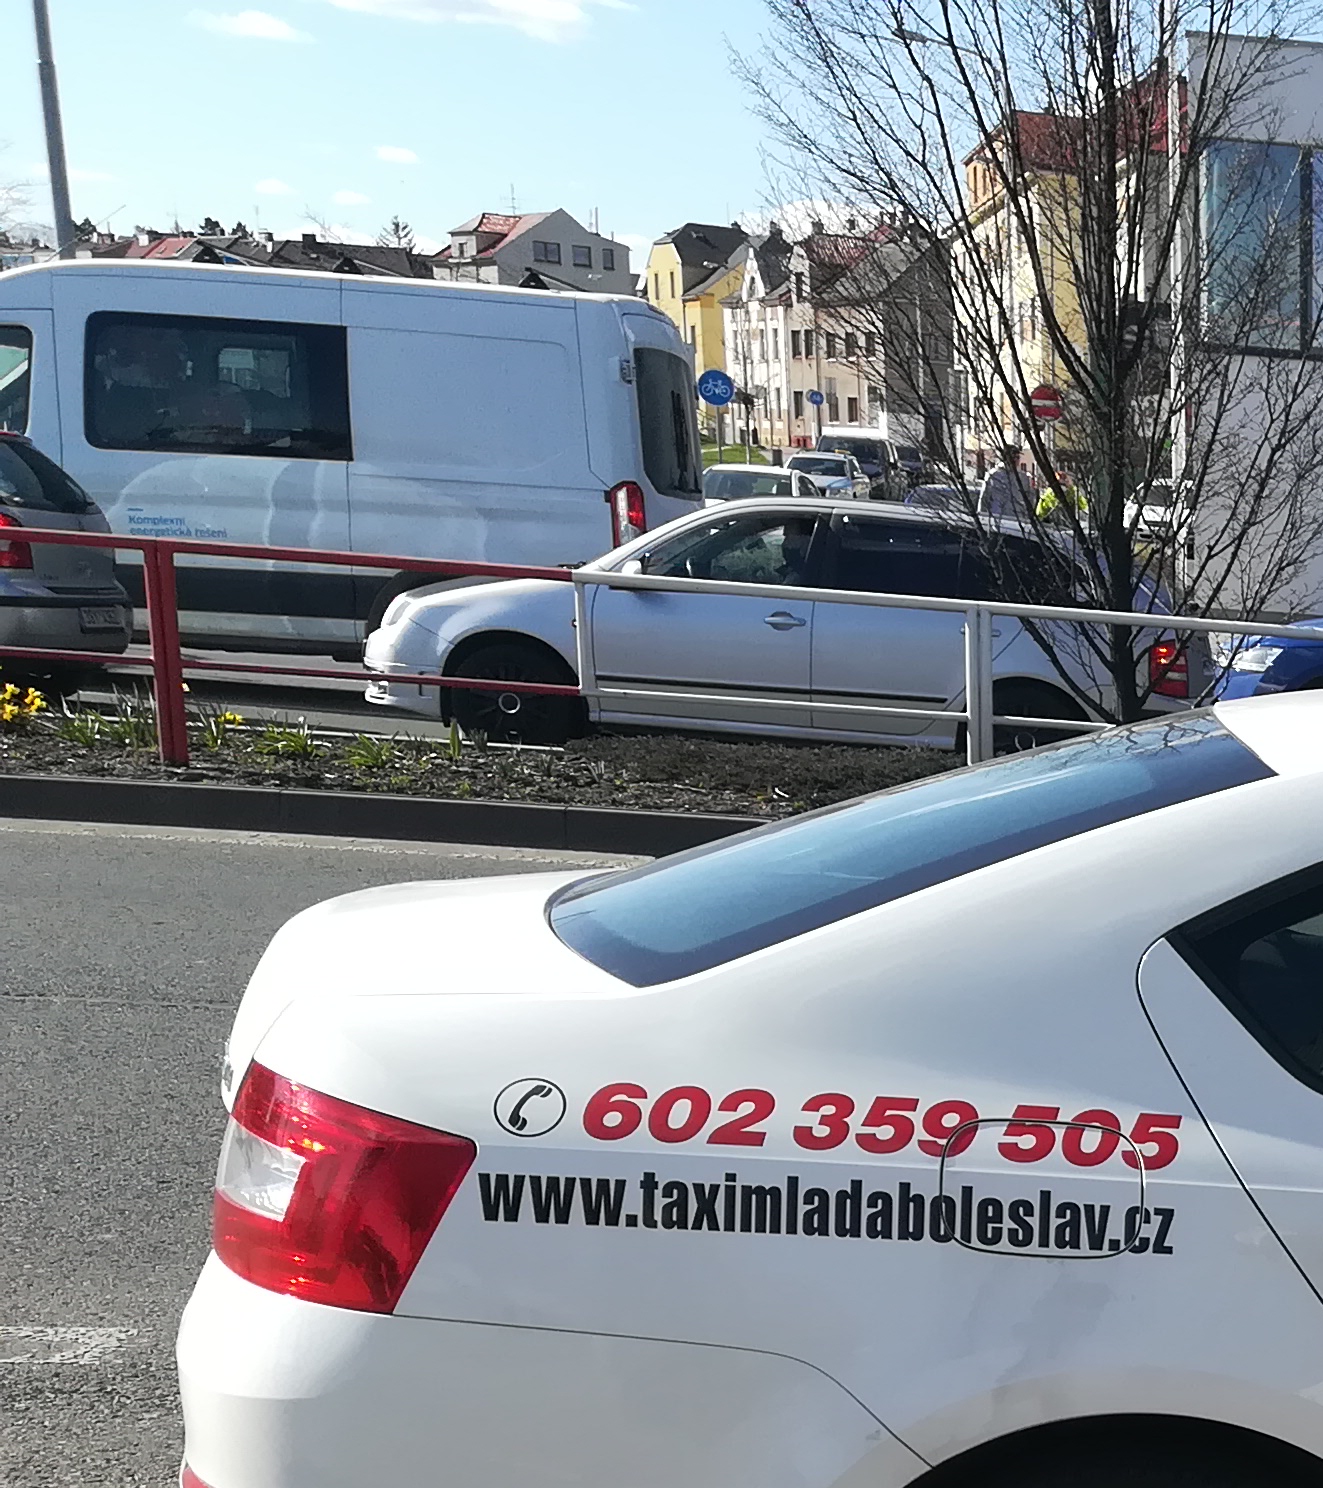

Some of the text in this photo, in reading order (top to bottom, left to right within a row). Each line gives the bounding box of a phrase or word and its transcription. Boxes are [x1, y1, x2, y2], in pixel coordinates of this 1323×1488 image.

[583, 1082, 1182, 1171] 602 359 505
[478, 1171, 1174, 1255] www.taximladaboleslav.cz
